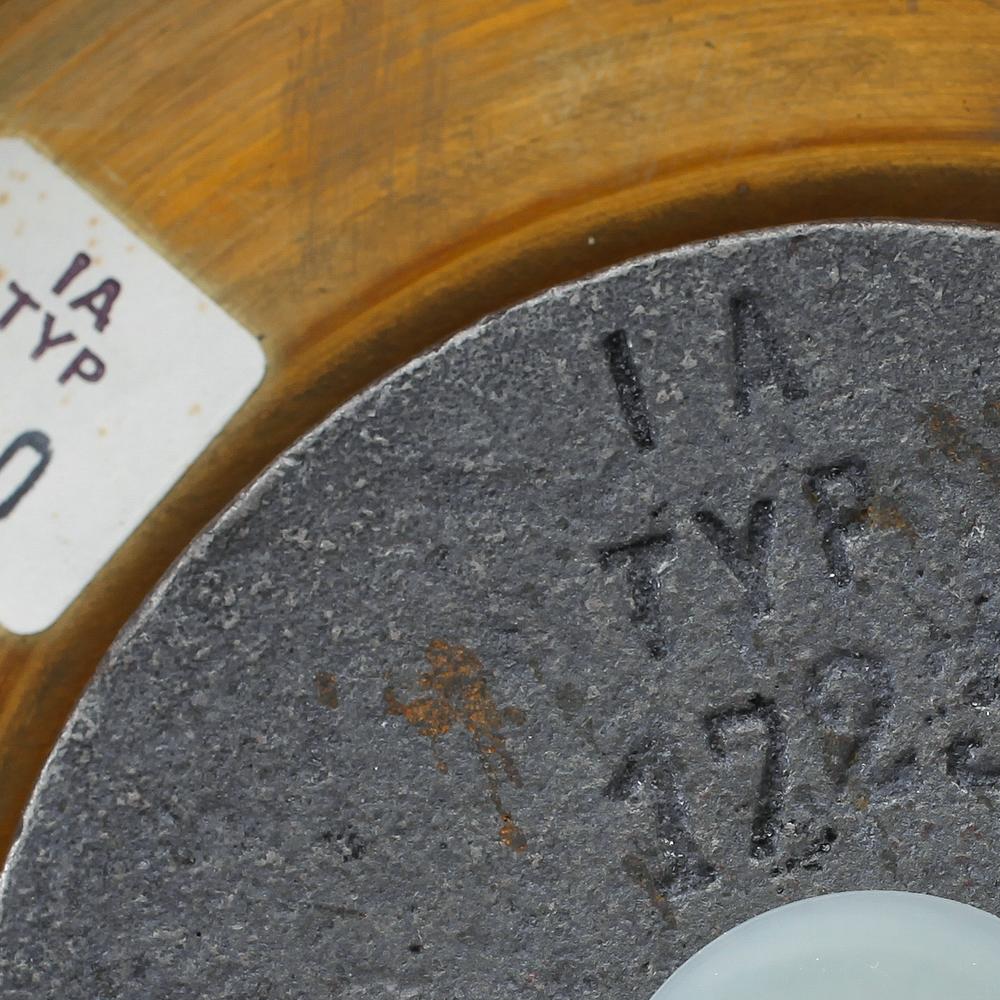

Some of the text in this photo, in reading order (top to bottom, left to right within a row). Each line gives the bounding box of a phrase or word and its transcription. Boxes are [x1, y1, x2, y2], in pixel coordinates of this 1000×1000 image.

[0, 281, 106, 384] TYP
[52, 252, 121, 334] IA
[598, 456, 870, 660] TYP
